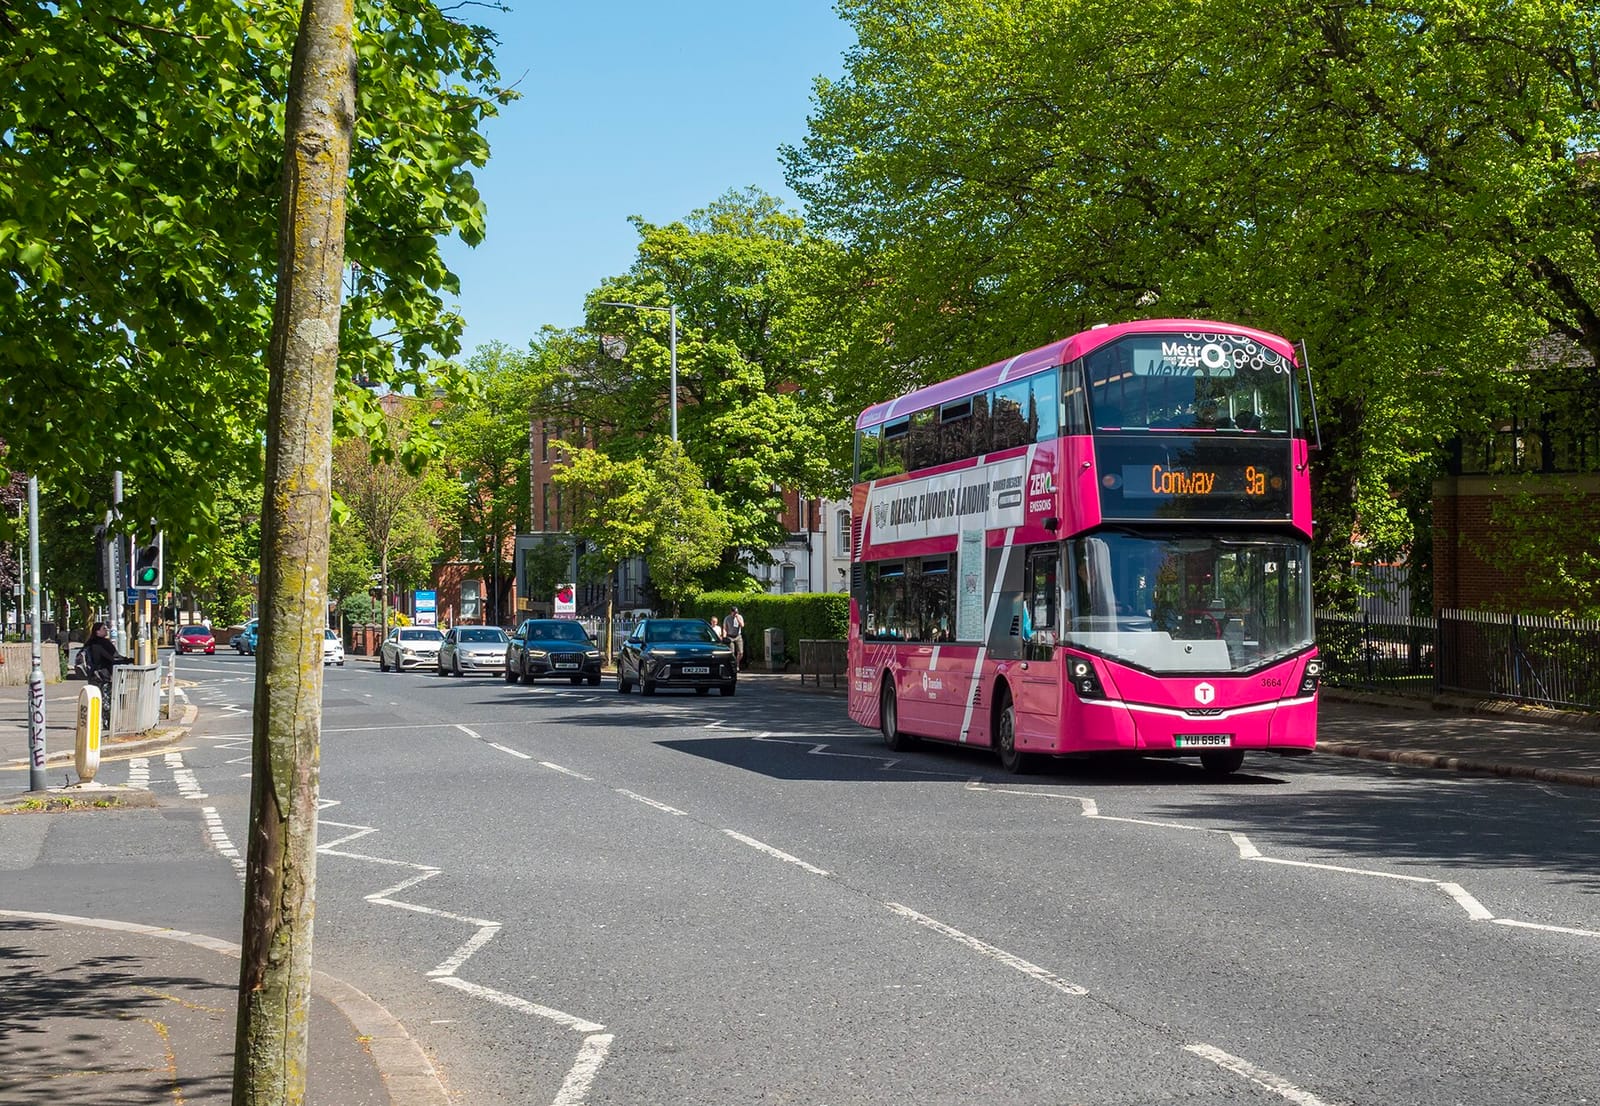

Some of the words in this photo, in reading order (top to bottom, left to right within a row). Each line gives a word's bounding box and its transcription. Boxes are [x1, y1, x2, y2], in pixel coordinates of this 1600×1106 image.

[1030, 471, 1052, 496] ZERO
[1152, 465, 1215, 495] Conway
[1245, 465, 1265, 495] 9a
[1261, 678, 1282, 687] 3664
[1184, 735, 1200, 745] YUI
[1202, 735, 1226, 745] 6964
